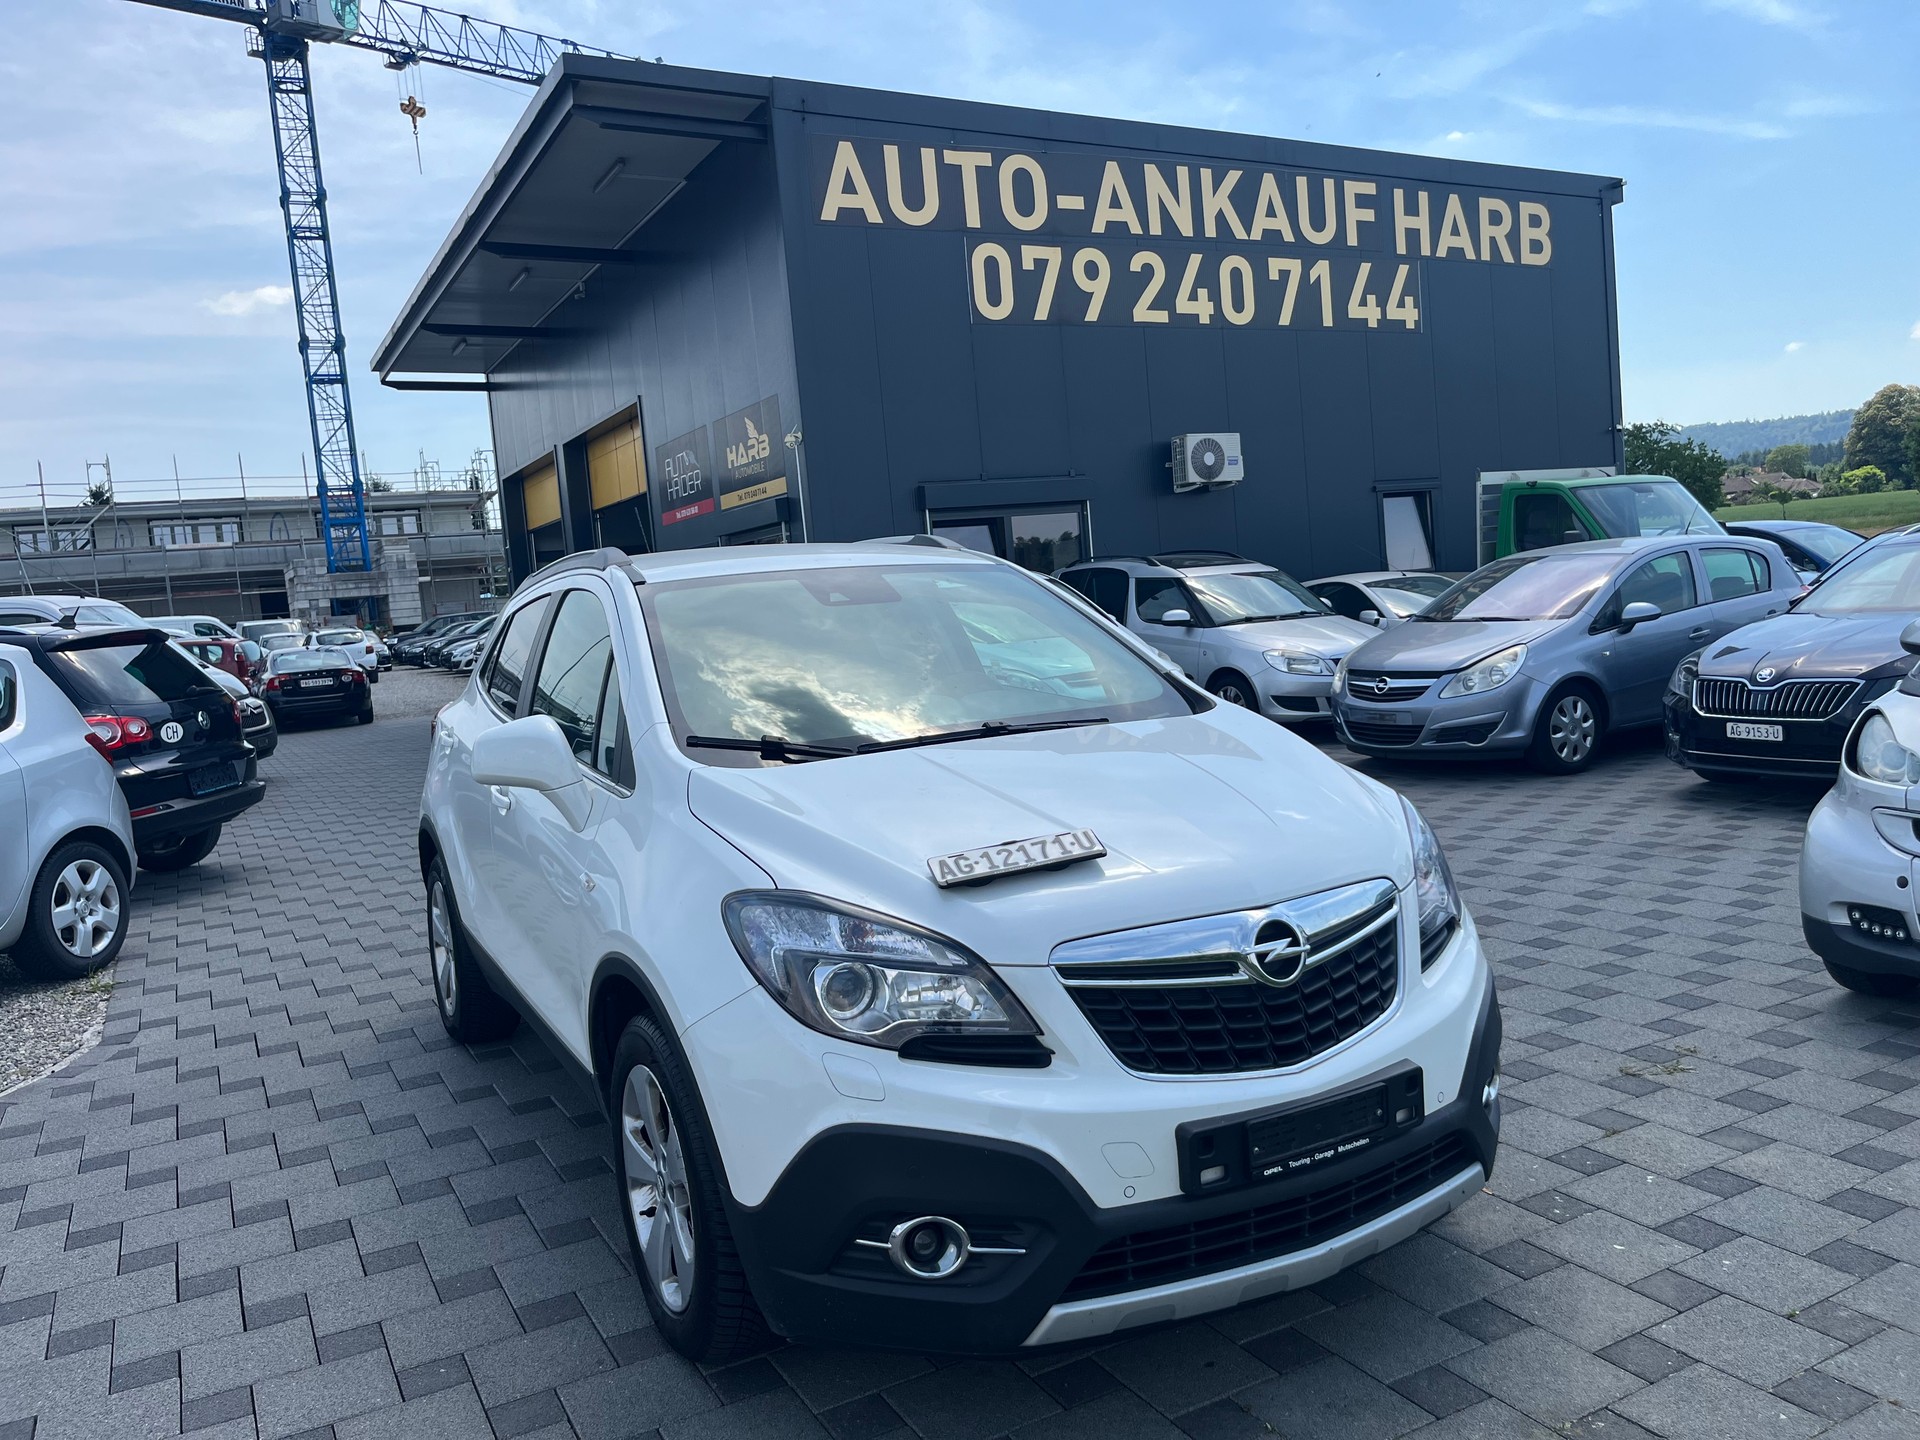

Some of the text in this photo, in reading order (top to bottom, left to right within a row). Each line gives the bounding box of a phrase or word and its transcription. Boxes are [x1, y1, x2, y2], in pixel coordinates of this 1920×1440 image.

[822, 142, 1551, 264] AUTO-ANKAUF HARB
[973, 243, 1418, 328] 079 240 71 44
[726, 433, 770, 469] HARB
[165, 725, 179, 740] CH
[1263, 1166, 1283, 1176] OPEL
[1288, 1156, 1311, 1168] Touring
[1314, 1149, 1335, 1160] Garage
